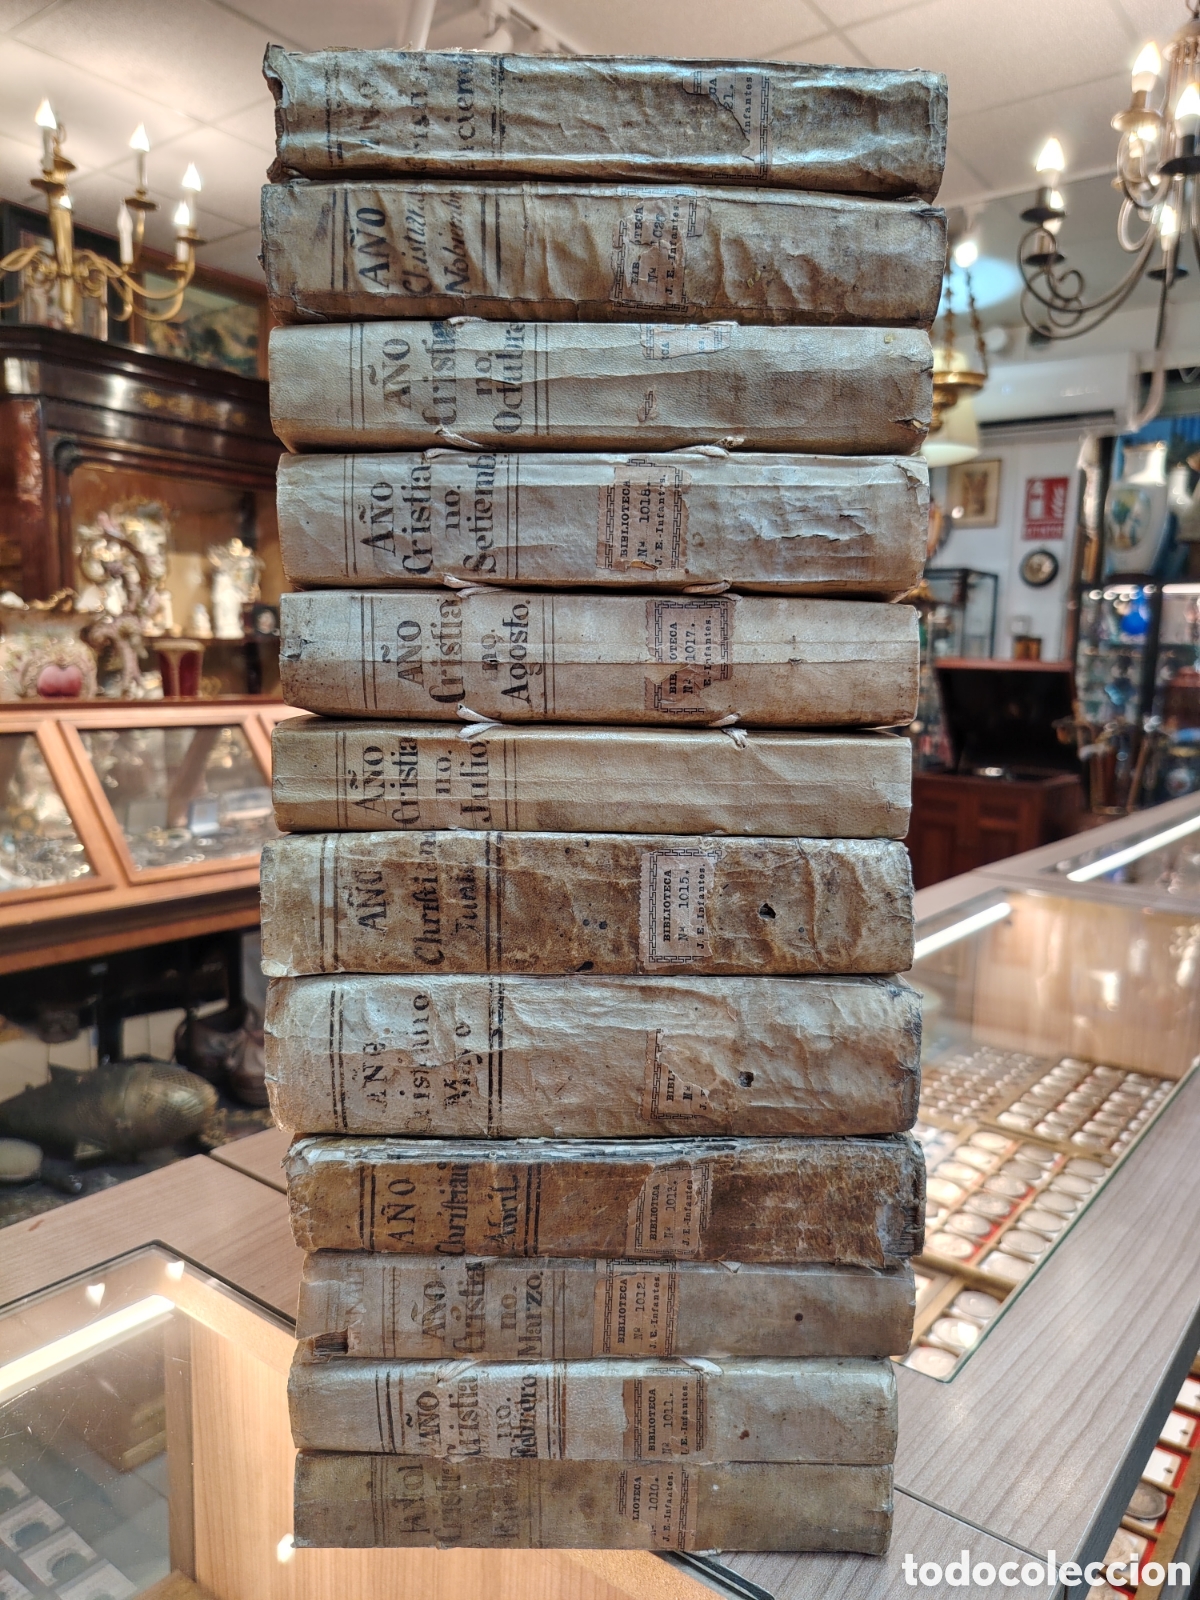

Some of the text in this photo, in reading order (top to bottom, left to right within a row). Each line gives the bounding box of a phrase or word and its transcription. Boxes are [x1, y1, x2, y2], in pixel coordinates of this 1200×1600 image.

[349, 207, 390, 291] AÑO
[367, 338, 411, 411] AÑO
[401, 463, 433, 576] Cristia
[620, 480, 631, 557] BIBLIOTECA
[381, 620, 424, 690] AÑO
[428, 599, 465, 704] Cristia
[500, 600, 542, 706] Agosto.
[390, 737, 420, 826] Cristia
[435, 750, 453, 796] no.
[460, 740, 491, 823] Julio.
[663, 870, 672, 942] BIBLIOTECA
[679, 869, 689, 908] 1015.
[381, 1177, 416, 1245] AÑO
[649, 1184, 660, 1240] BIBLIOTECA
[501, 1286, 517, 1331] no.
[617, 1278, 628, 1344] BIBLIOTECA
[635, 1276, 646, 1312] 1012.
[405, 1391, 441, 1446] AÑO
[648, 1388, 656, 1451] BIBLIOTECA
[663, 1392, 674, 1429] 1011.
